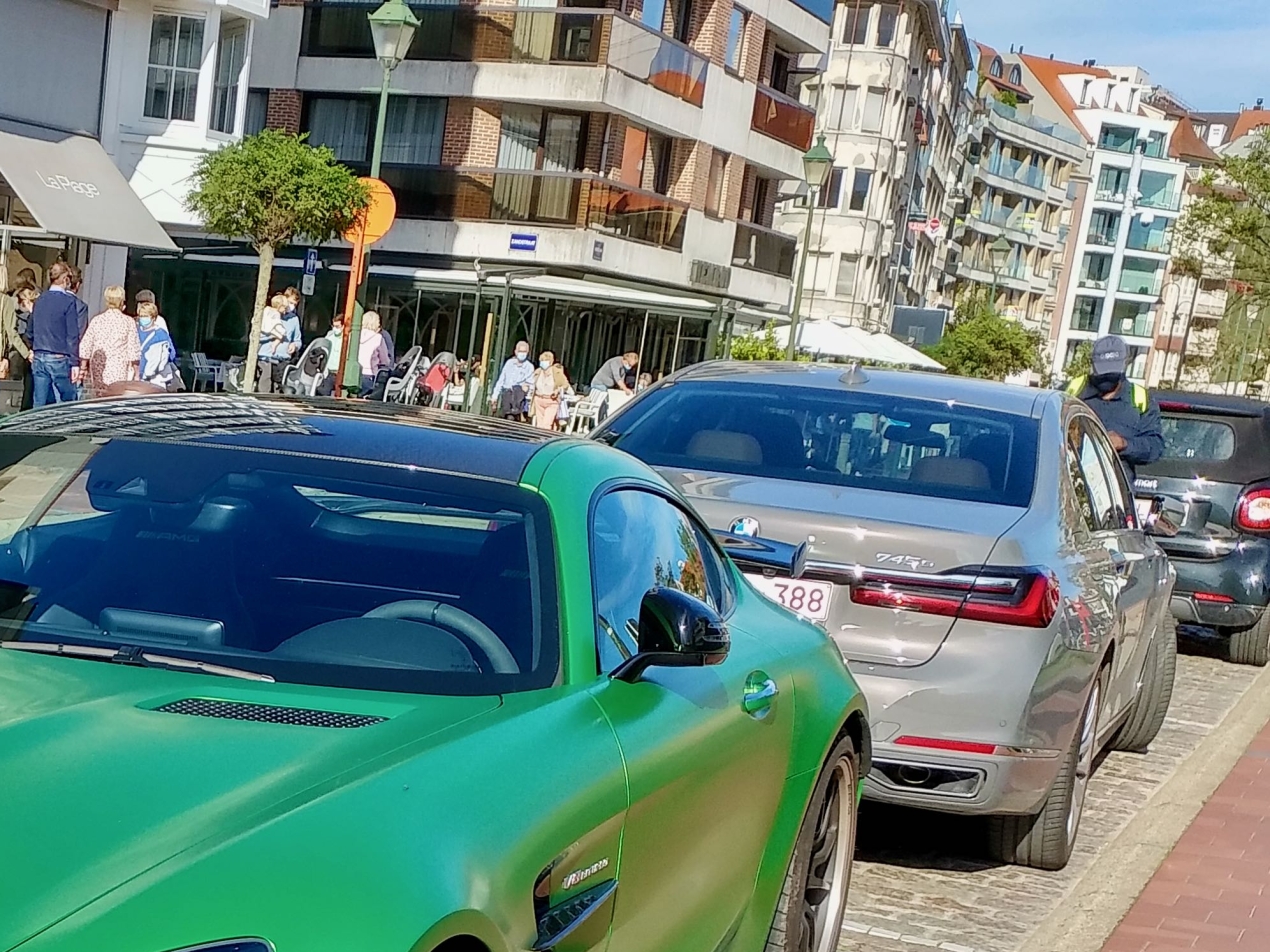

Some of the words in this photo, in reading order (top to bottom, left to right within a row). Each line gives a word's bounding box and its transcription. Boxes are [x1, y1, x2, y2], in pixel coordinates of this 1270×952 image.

[35, 170, 58, 189] La
[55, 174, 100, 198] Plage
[774, 583, 824, 612] 388
